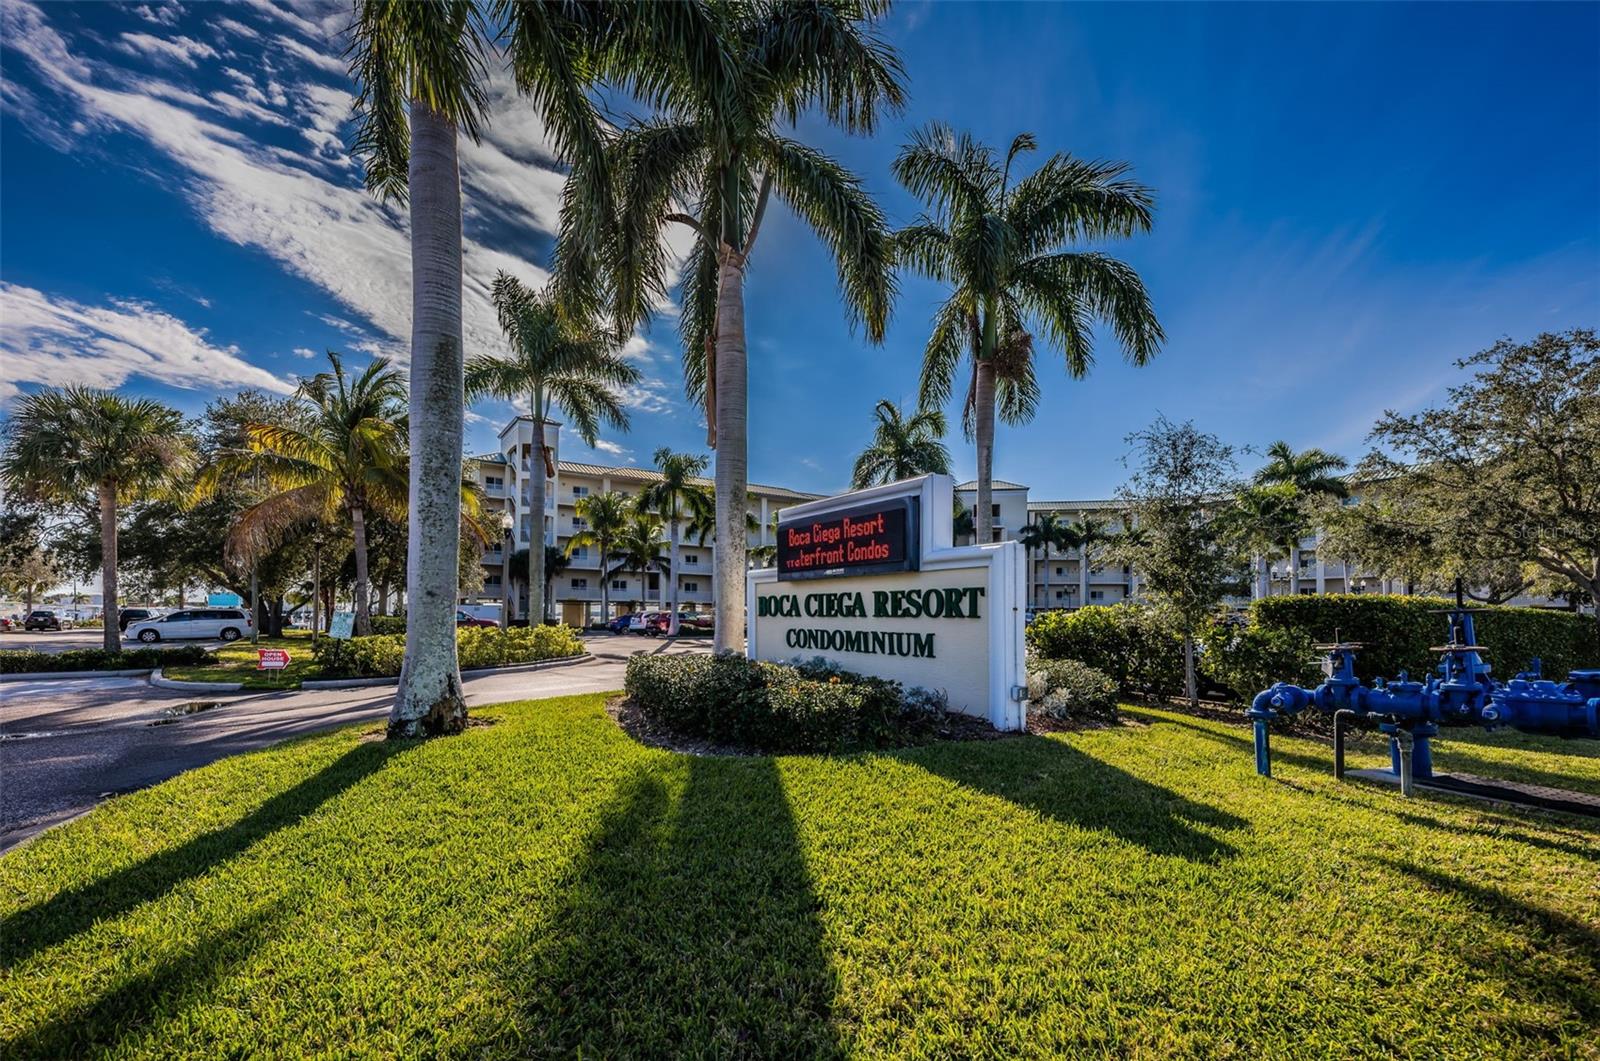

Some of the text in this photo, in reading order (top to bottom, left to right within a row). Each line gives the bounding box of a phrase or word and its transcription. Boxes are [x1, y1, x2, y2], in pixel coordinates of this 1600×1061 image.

[788, 513, 885, 547] Boca Ciega Resort
[847, 540, 889, 562] Condos
[758, 587, 985, 619] BOCA CIEGA RESORT
[786, 628, 936, 658] CONDOMINIUM
